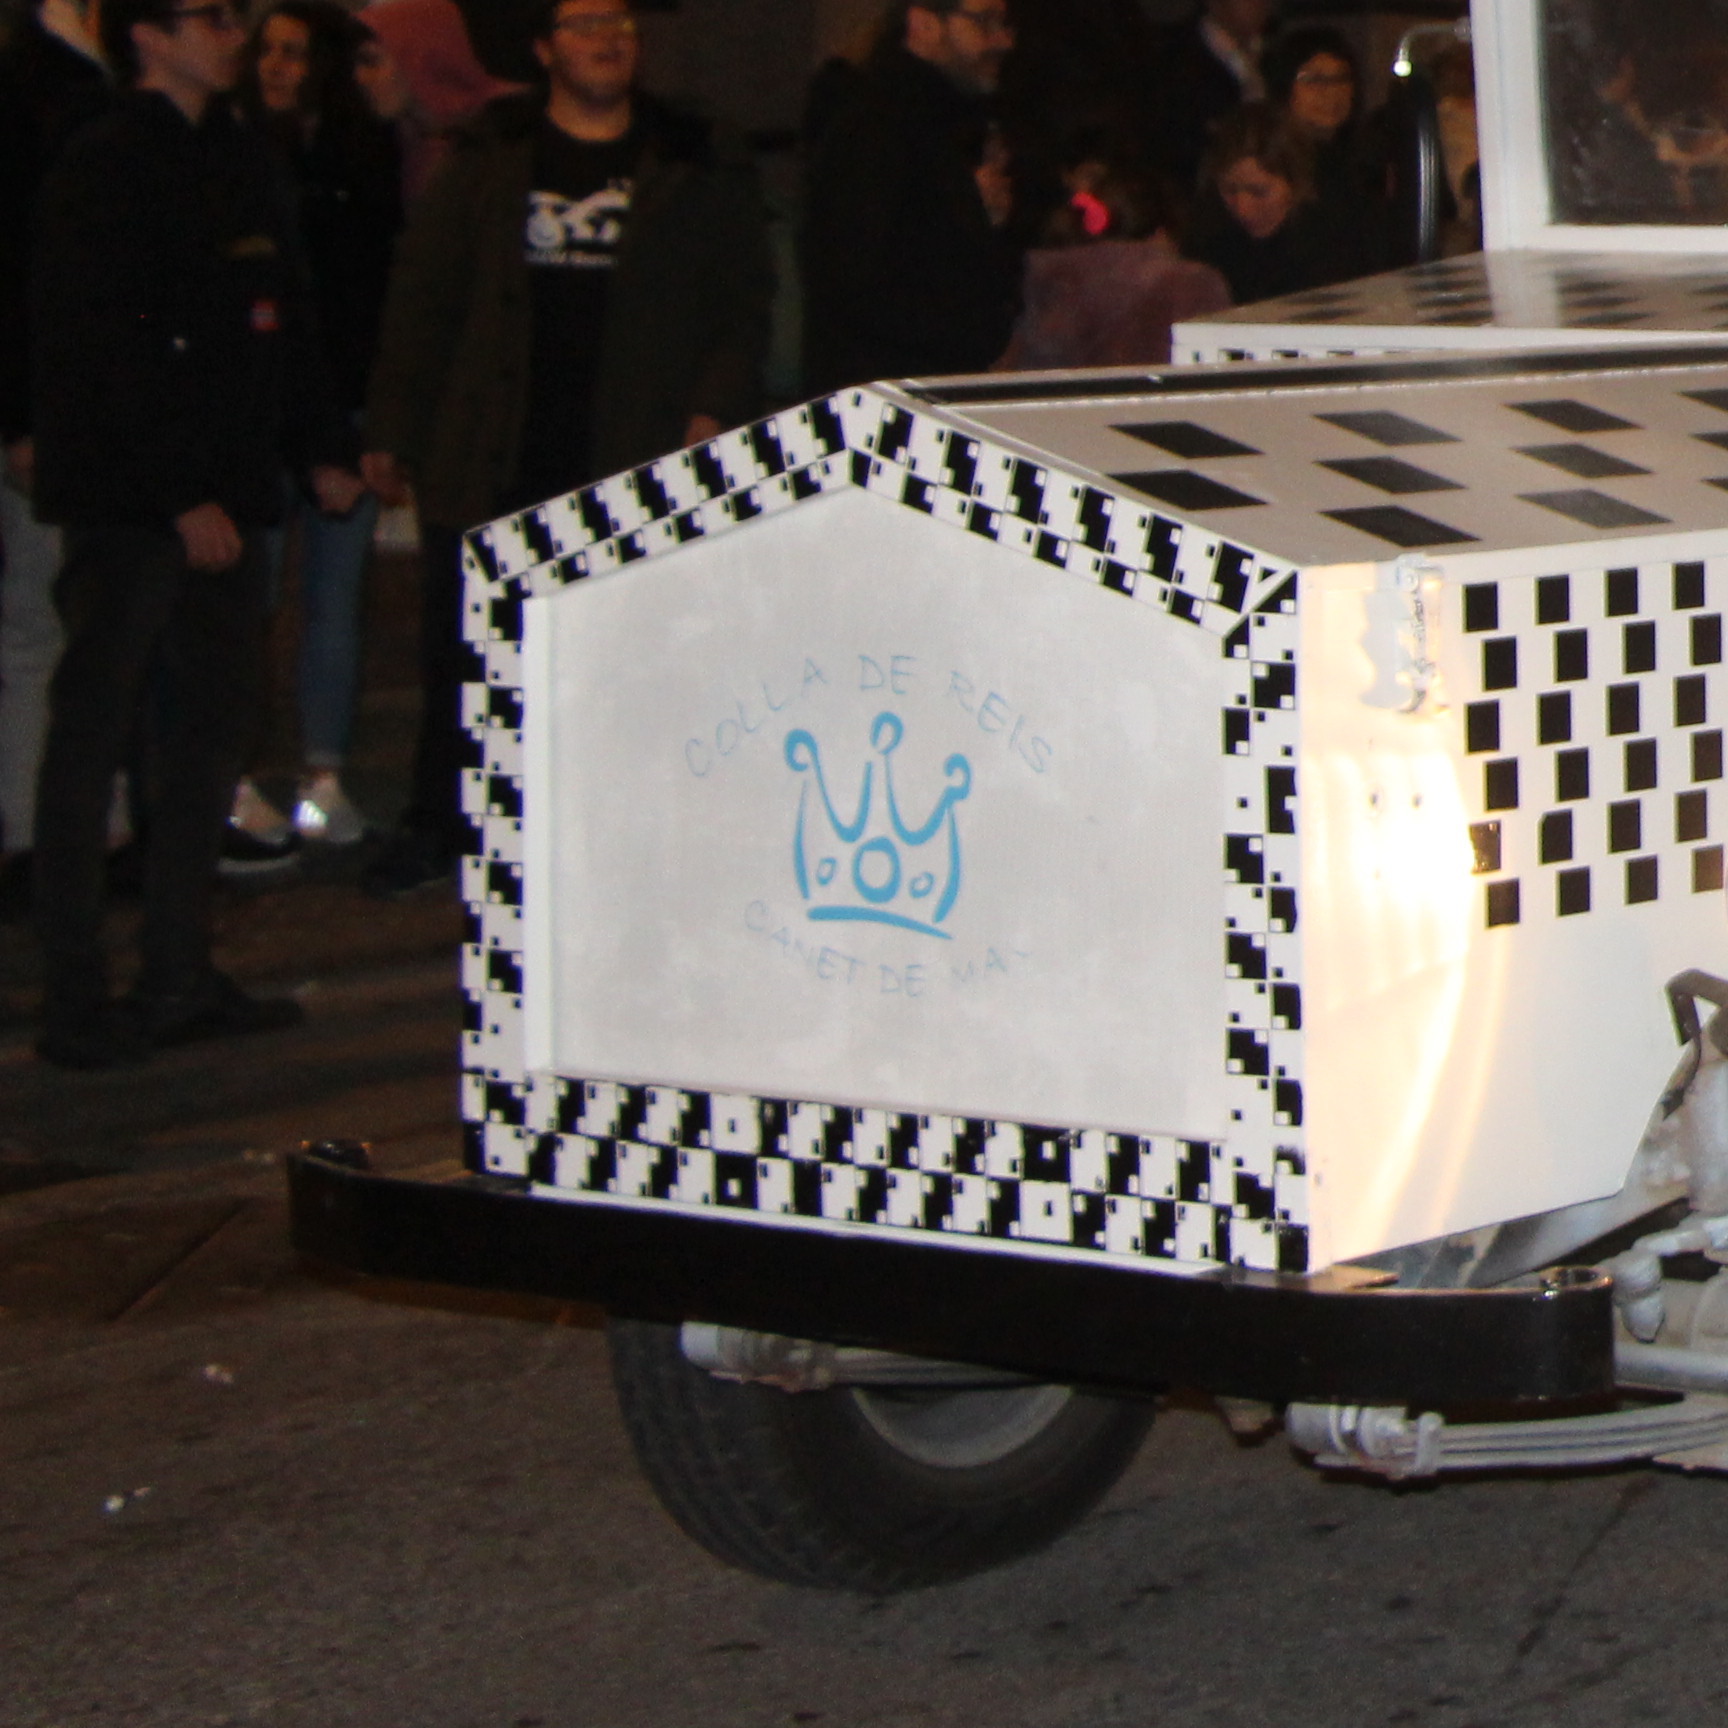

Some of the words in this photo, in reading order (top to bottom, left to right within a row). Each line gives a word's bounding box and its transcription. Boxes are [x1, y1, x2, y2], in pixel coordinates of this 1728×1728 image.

[685, 657, 827, 776] COLLA
[857, 654, 916, 695] DE
[948, 669, 1053, 774] REIS
